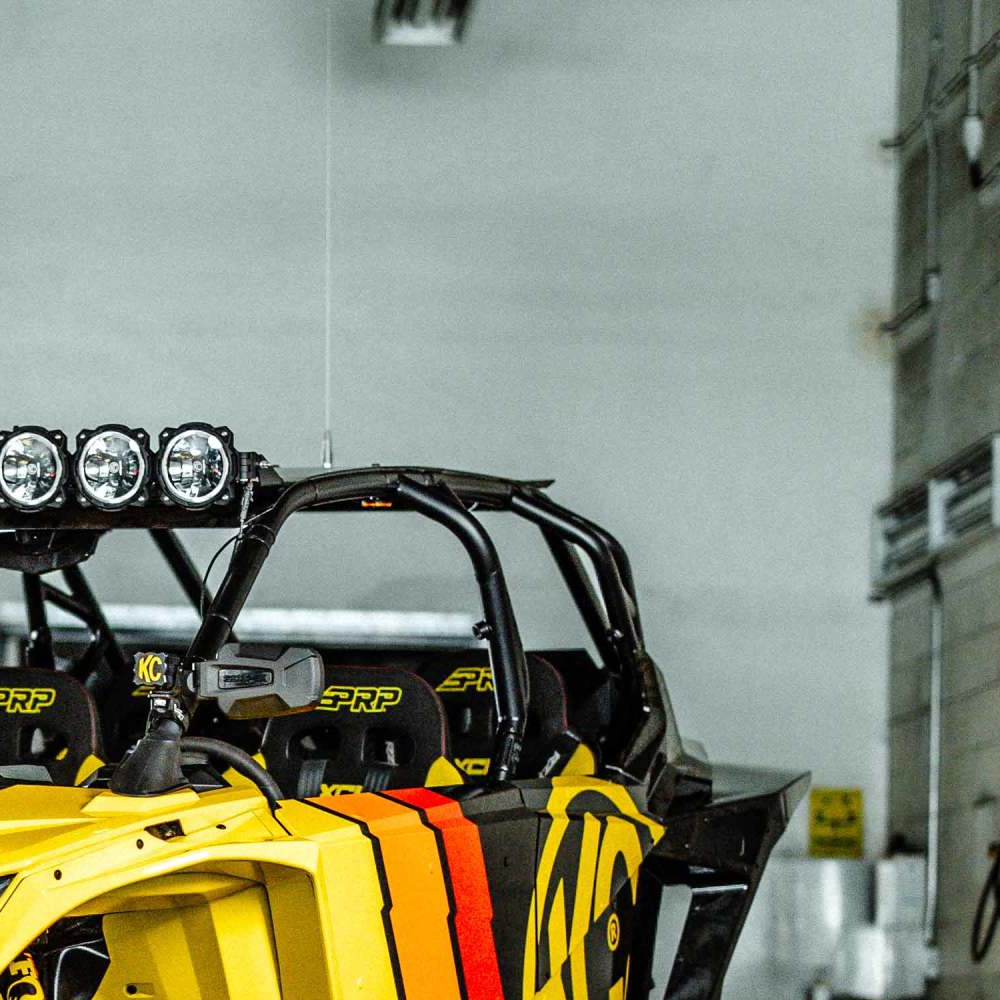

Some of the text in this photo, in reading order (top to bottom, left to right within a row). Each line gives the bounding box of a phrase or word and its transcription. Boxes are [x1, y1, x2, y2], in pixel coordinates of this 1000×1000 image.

[138, 654, 162, 682] KC
[435, 667, 494, 692] PR
[314, 686, 402, 712] PRP
